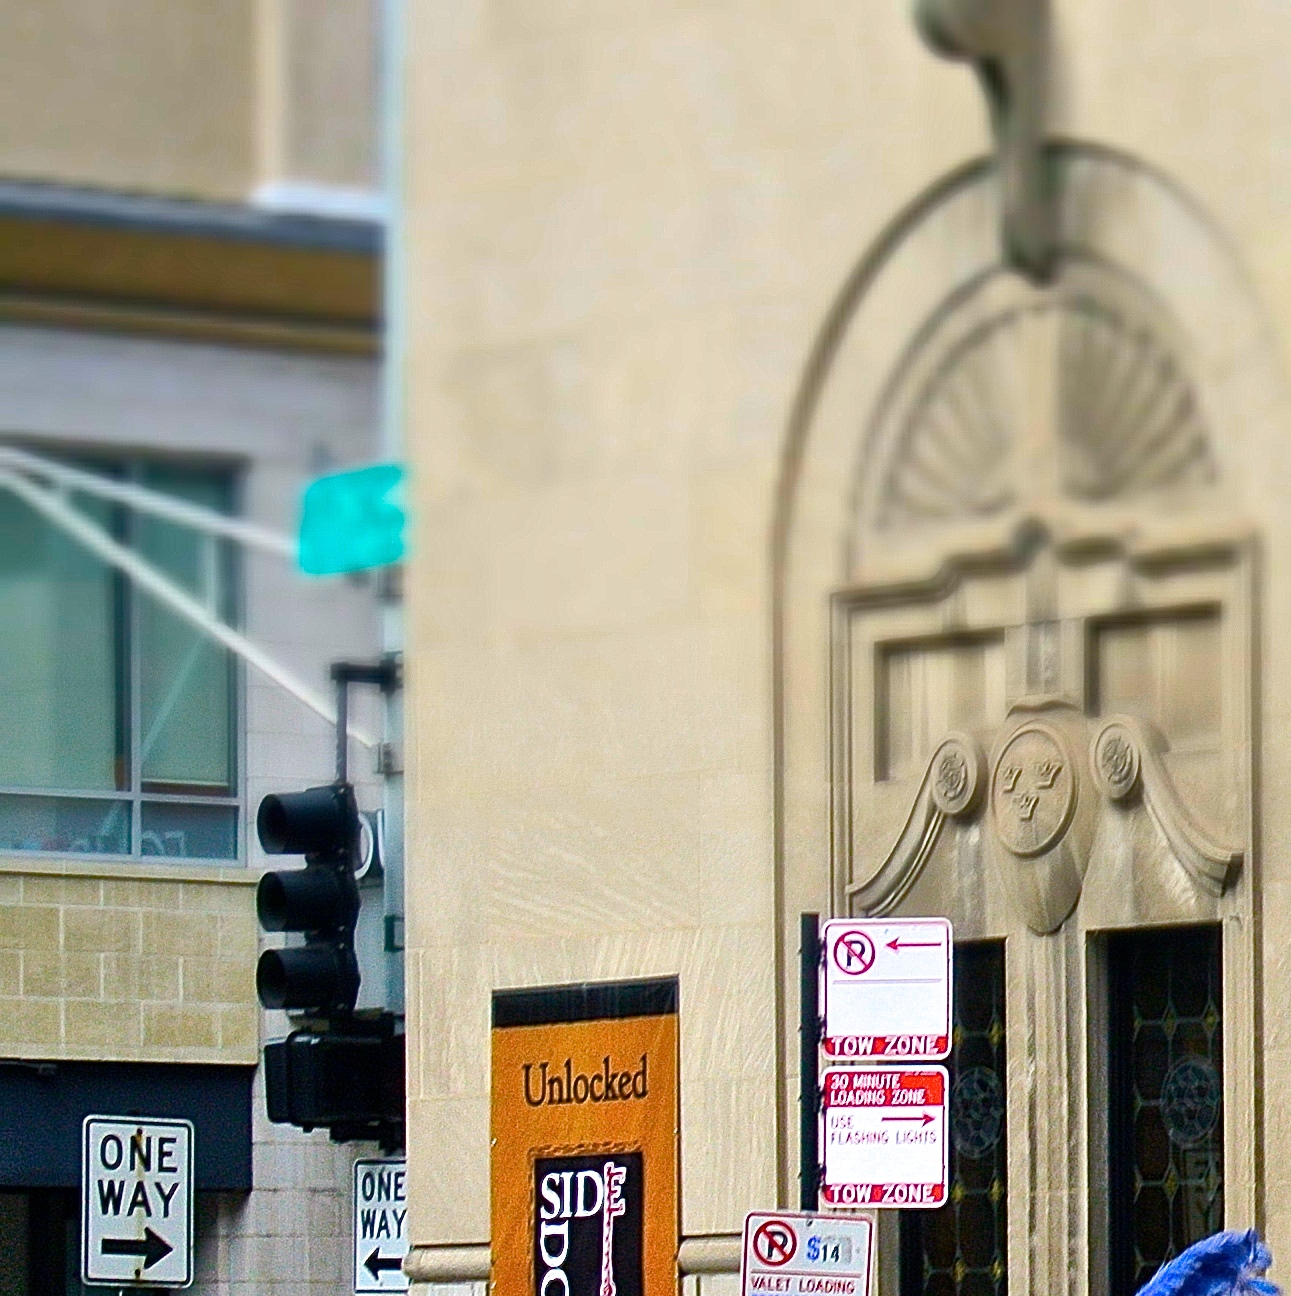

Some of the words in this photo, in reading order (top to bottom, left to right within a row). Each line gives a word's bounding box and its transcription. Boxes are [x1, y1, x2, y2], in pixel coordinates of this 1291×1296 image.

[831, 1036, 874, 1056] TOW
[884, 1035, 939, 1056] ZONE
[522, 1052, 648, 1107] Unlocked
[853, 1073, 901, 1090] MINUTE
[830, 1089, 886, 1106] LOADING
[891, 1088, 926, 1105] ZONE
[830, 1114, 855, 1130] USE
[830, 1129, 889, 1146] FLASHING
[895, 1129, 938, 1146] LIGHTS
[99, 1133, 179, 1174] ONE
[97, 1179, 180, 1218] WAY
[361, 1171, 407, 1202] ONE
[540, 1162, 627, 1219] SIDE
[830, 1183, 873, 1204] TOW
[881, 1182, 936, 1204] ZONE
[360, 1208, 407, 1240] WAY
[807, 1235, 840, 1263] $14
[751, 1276, 791, 1292] VALET
[799, 1278, 856, 1295] LOADING
